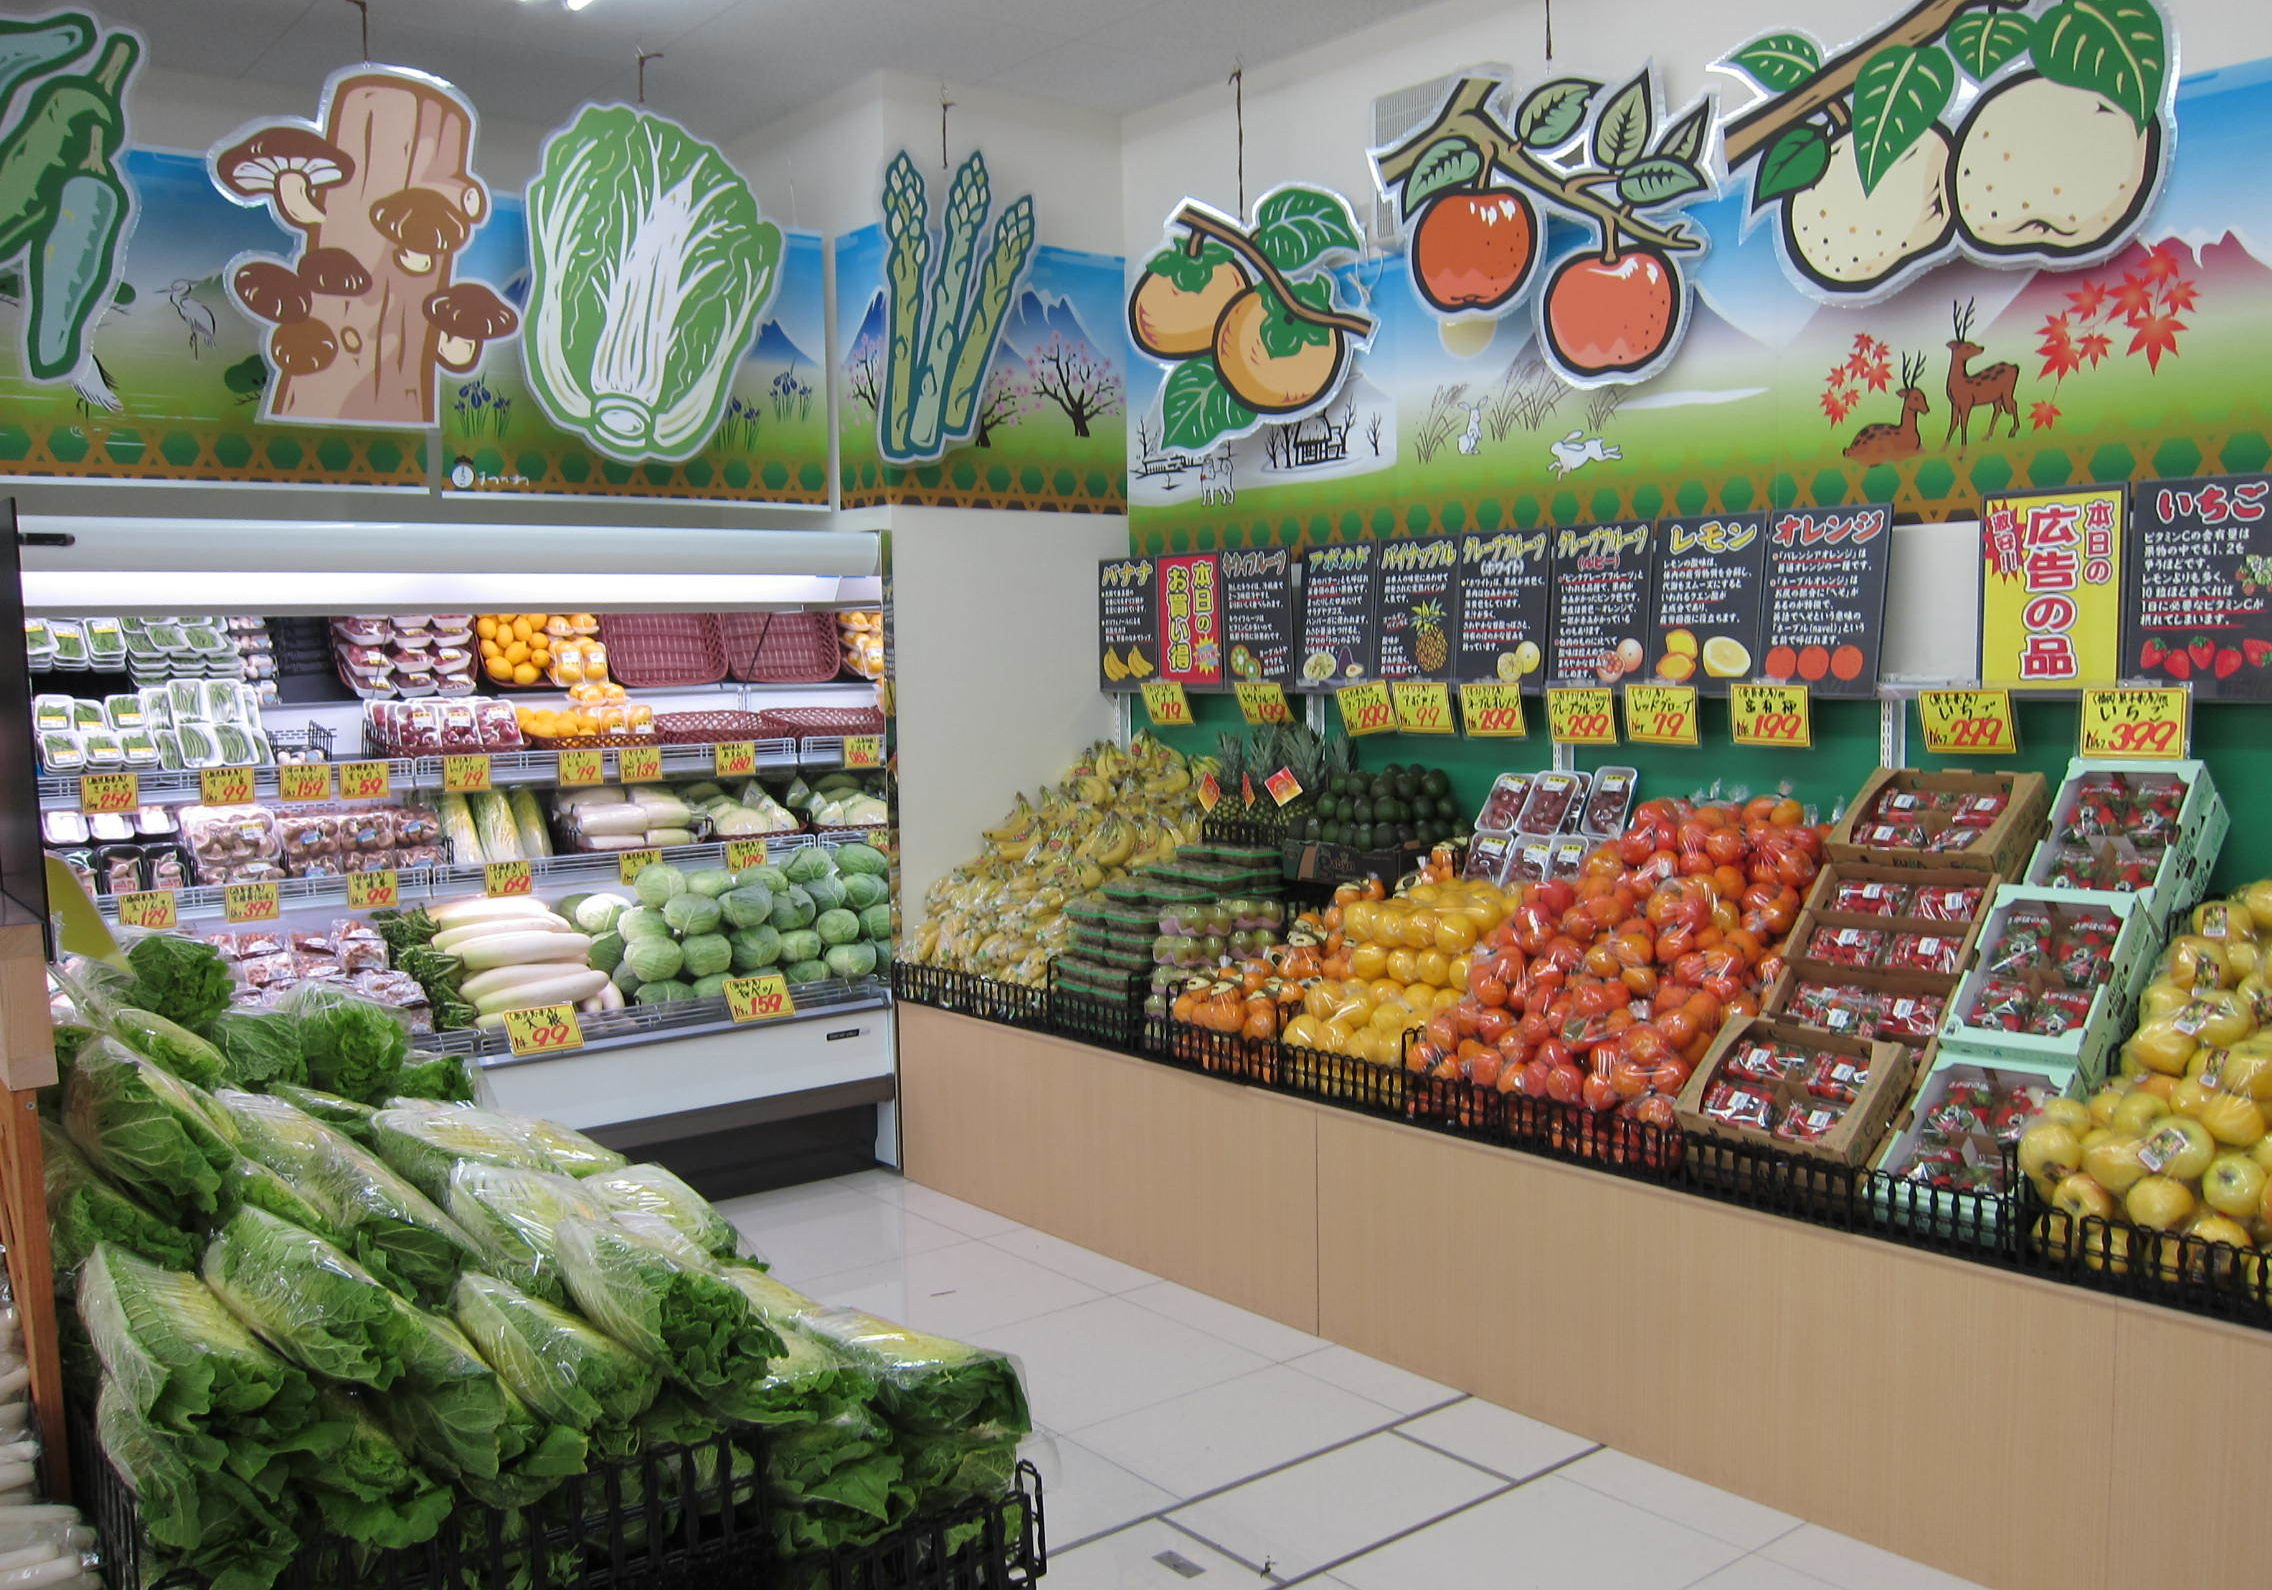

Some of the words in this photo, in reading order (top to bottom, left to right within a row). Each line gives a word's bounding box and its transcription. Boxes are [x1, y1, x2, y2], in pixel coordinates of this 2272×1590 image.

[2156, 482, 2268, 524] いちご
[1669, 520, 1757, 555] レモン
[1771, 509, 1884, 548] オレンジ
[1463, 533, 1547, 564] グレープフルーツ
[1557, 524, 1649, 560] グレープフルーツ
[2084, 499, 2115, 585] 本日の
[1222, 549, 1287, 579] キウイフルーツ
[1309, 545, 1371, 573] アボカド
[1381, 540, 1456, 571] パイナップル
[1102, 560, 1153, 587] バナナ
[1191, 560, 1214, 633] 本日の
[2019, 503, 2083, 681] 広告の品
[1167, 565, 1191, 672] お買い得
[1161, 702, 1182, 719] 79
[1258, 704, 1287, 719] 199
[1358, 703, 1389, 727] 299
[1416, 706, 1440, 727] 99
[1479, 707, 1517, 730] 299
[2100, 704, 2168, 722] いちご
[1567, 713, 1609, 737] 299
[1653, 712, 1684, 736] 79
[1753, 712, 1802, 739] 199
[1951, 717, 2004, 746] 299
[2108, 720, 2178, 751] 399
[464, 770, 484, 786] 79
[578, 765, 596, 780] 79
[637, 762, 658, 777] 139
[223, 785, 249, 801] 99
[297, 780, 323, 797] 159
[360, 778, 383, 795] 59
[100, 792, 133, 809] 259
[367, 887, 393, 903] 99
[504, 876, 531, 893] 69
[244, 900, 275, 917] 399
[751, 993, 783, 1015] 159
[532, 1024, 570, 1047] 99
